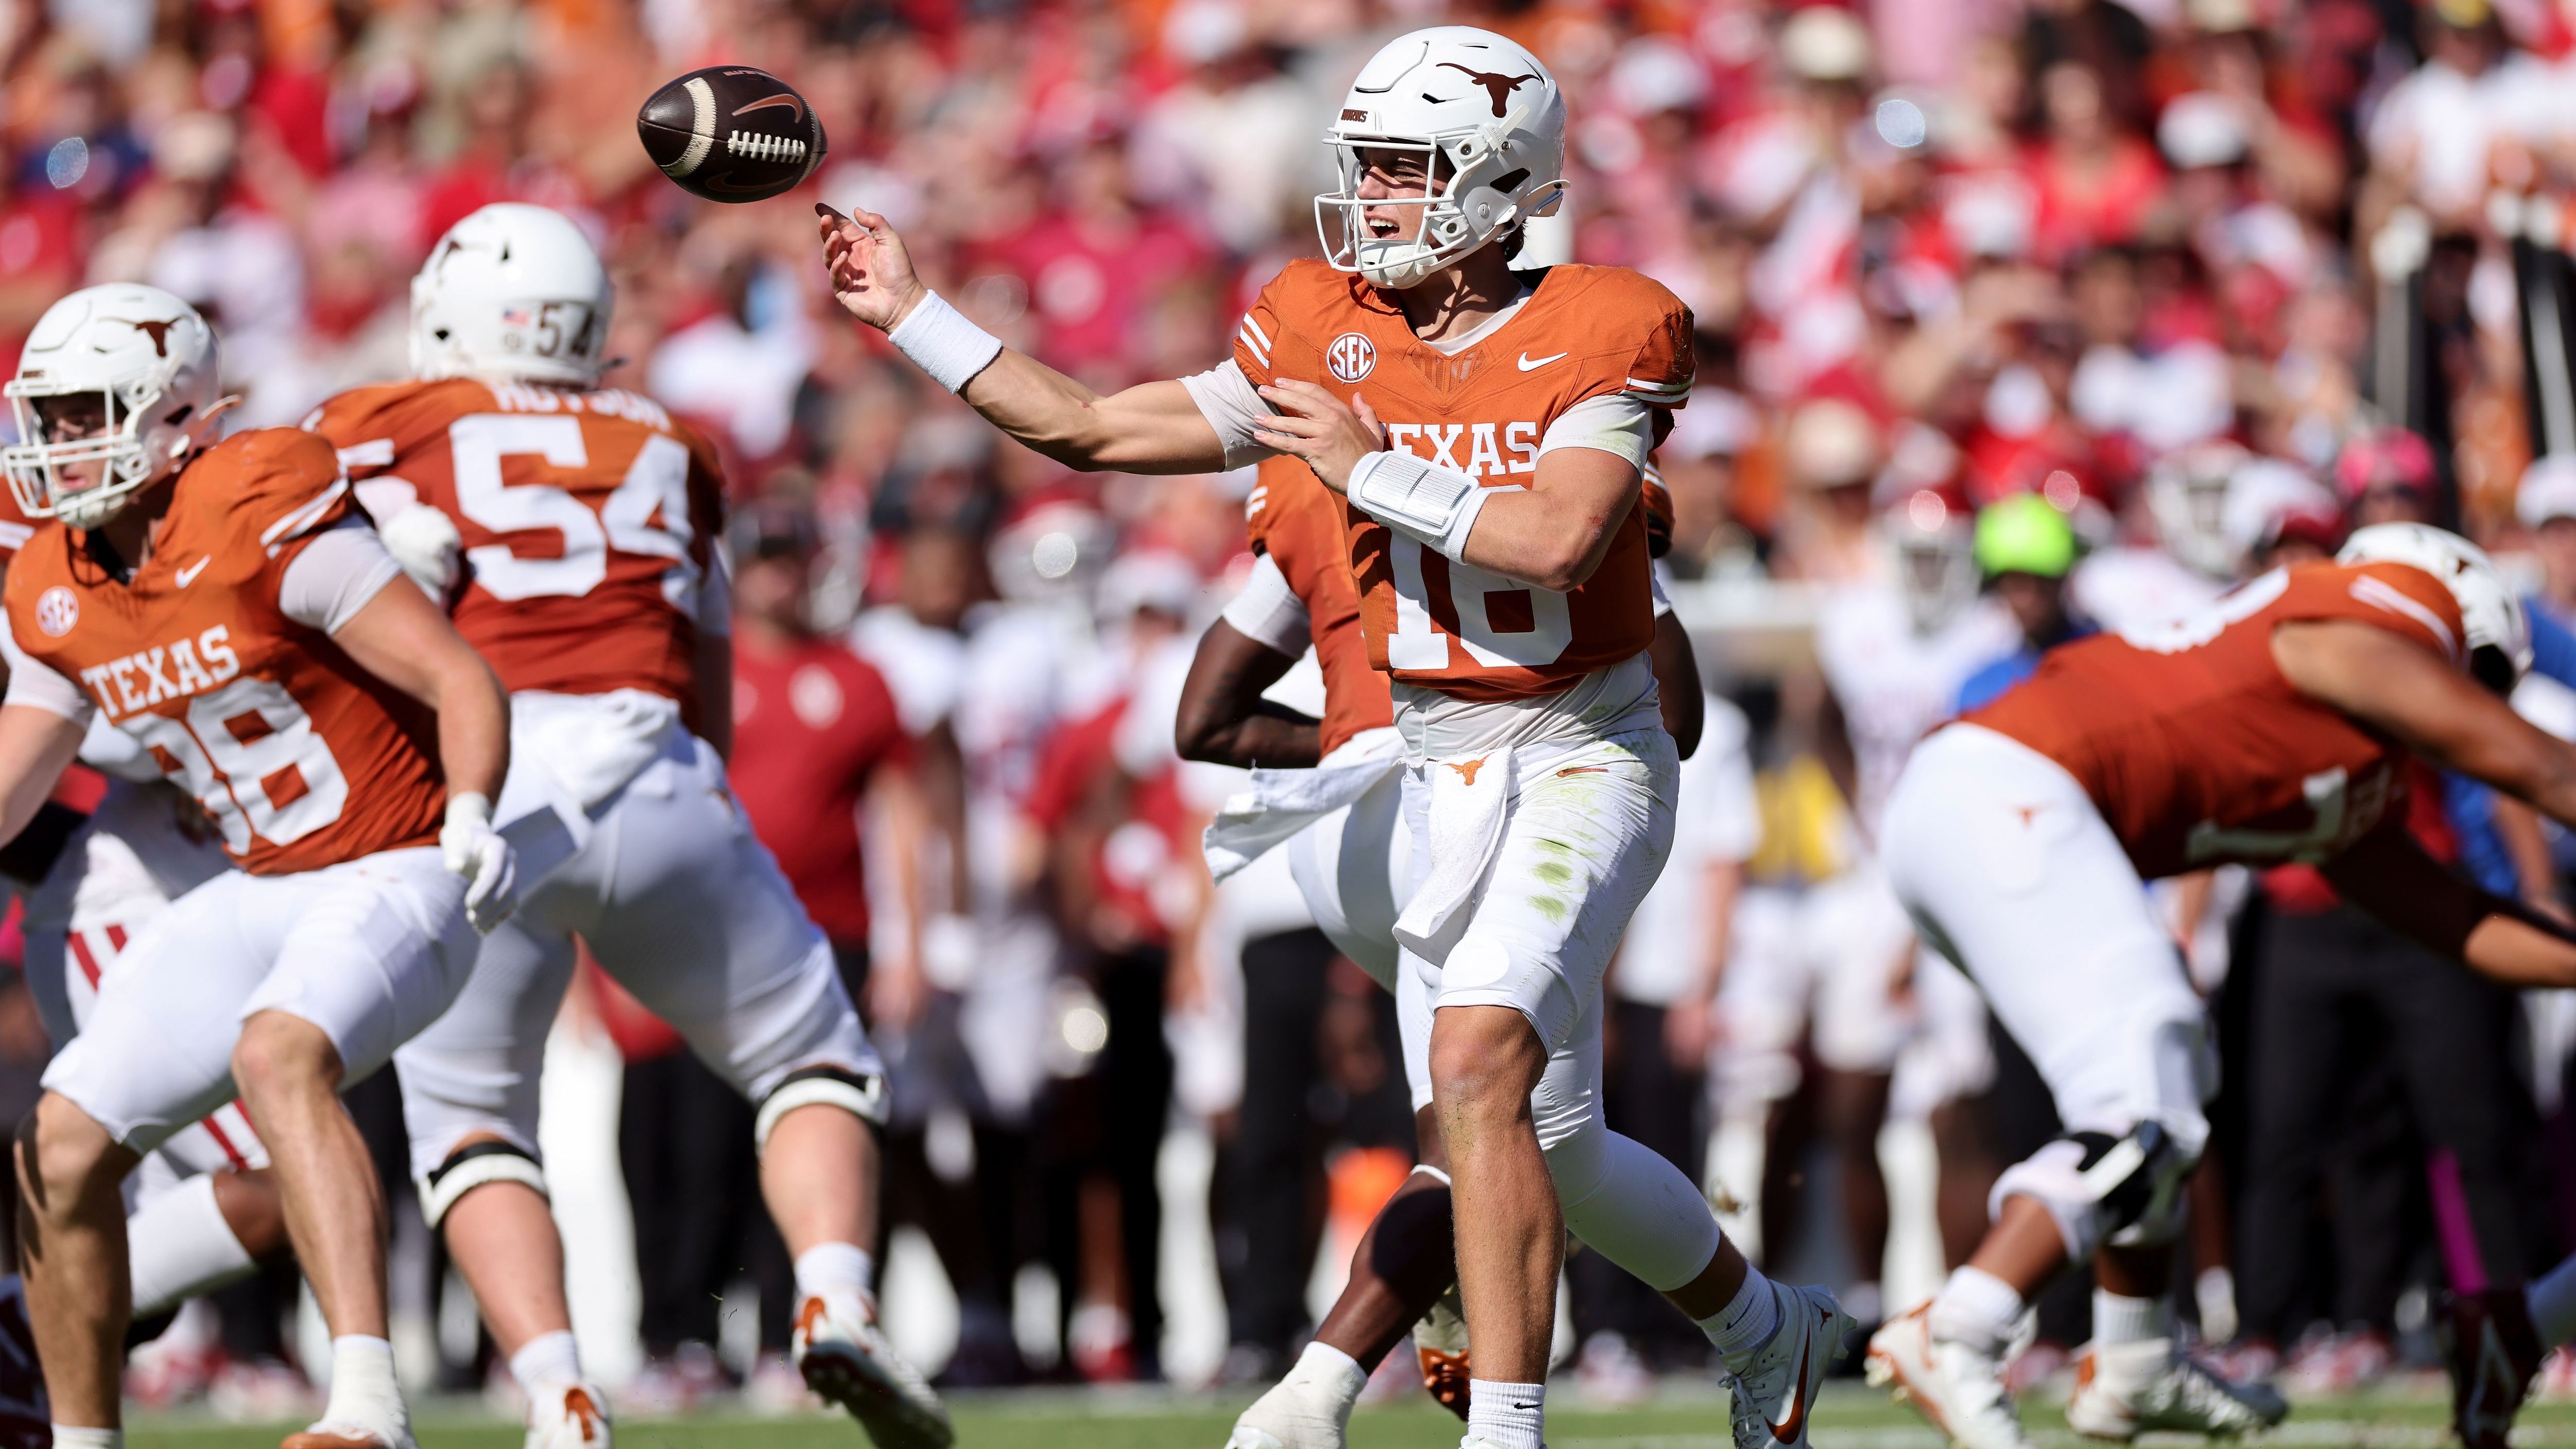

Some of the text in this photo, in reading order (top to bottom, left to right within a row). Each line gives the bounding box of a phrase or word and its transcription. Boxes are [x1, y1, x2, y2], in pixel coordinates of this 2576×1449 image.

[536, 303, 594, 357] 54
[1332, 335, 1372, 380] SEC
[1379, 421, 1538, 476] EXAS
[449, 413, 701, 614] 54
[80, 624, 240, 718] TEXAS
